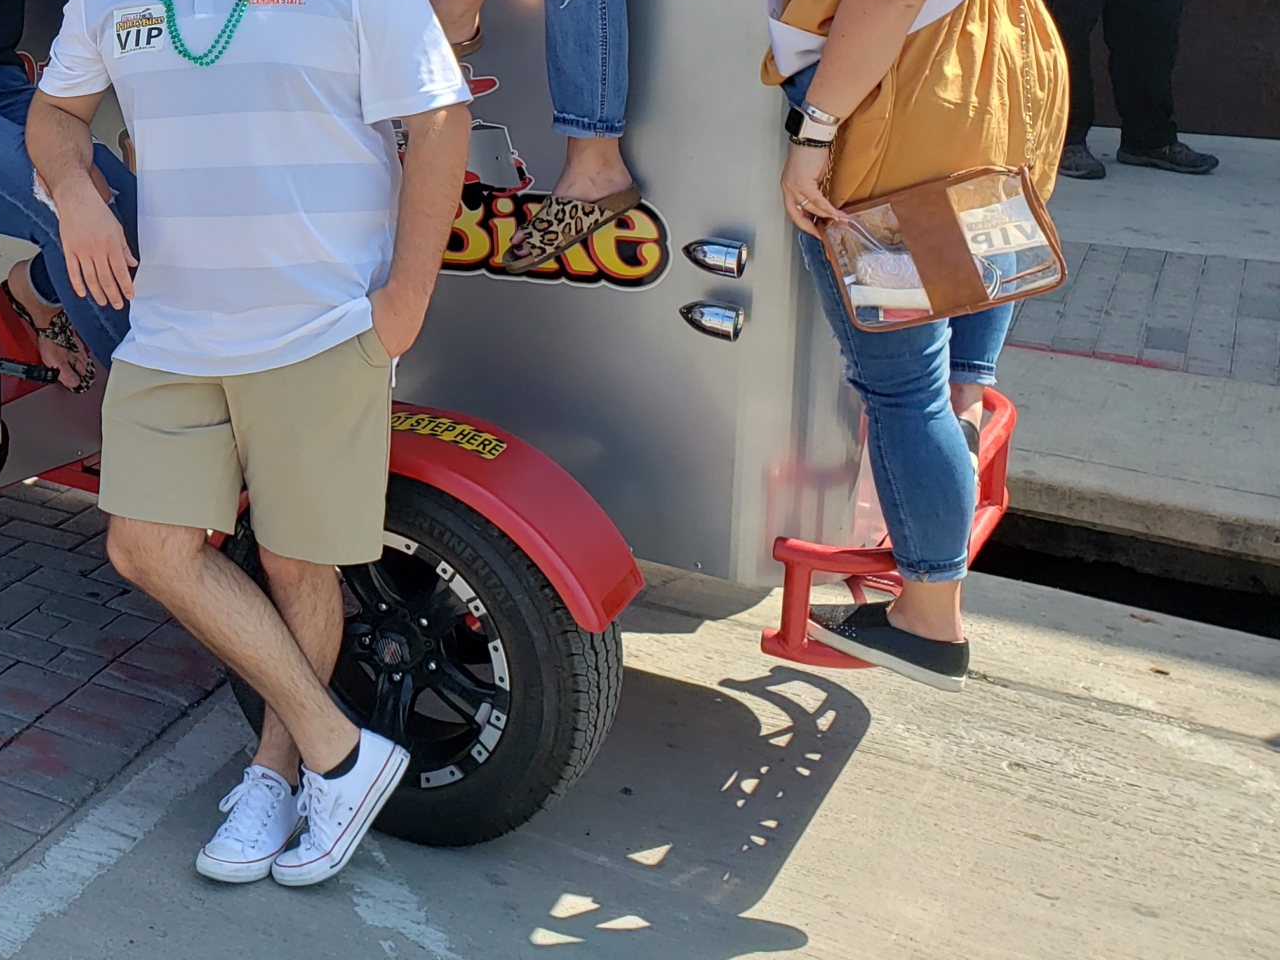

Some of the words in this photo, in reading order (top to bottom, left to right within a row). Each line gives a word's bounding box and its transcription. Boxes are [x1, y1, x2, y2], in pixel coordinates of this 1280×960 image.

[116, 26, 163, 50] VIP
[391, 416, 413, 426] OT
[410, 417, 457, 434] STEP
[454, 429, 504, 457] HERE
